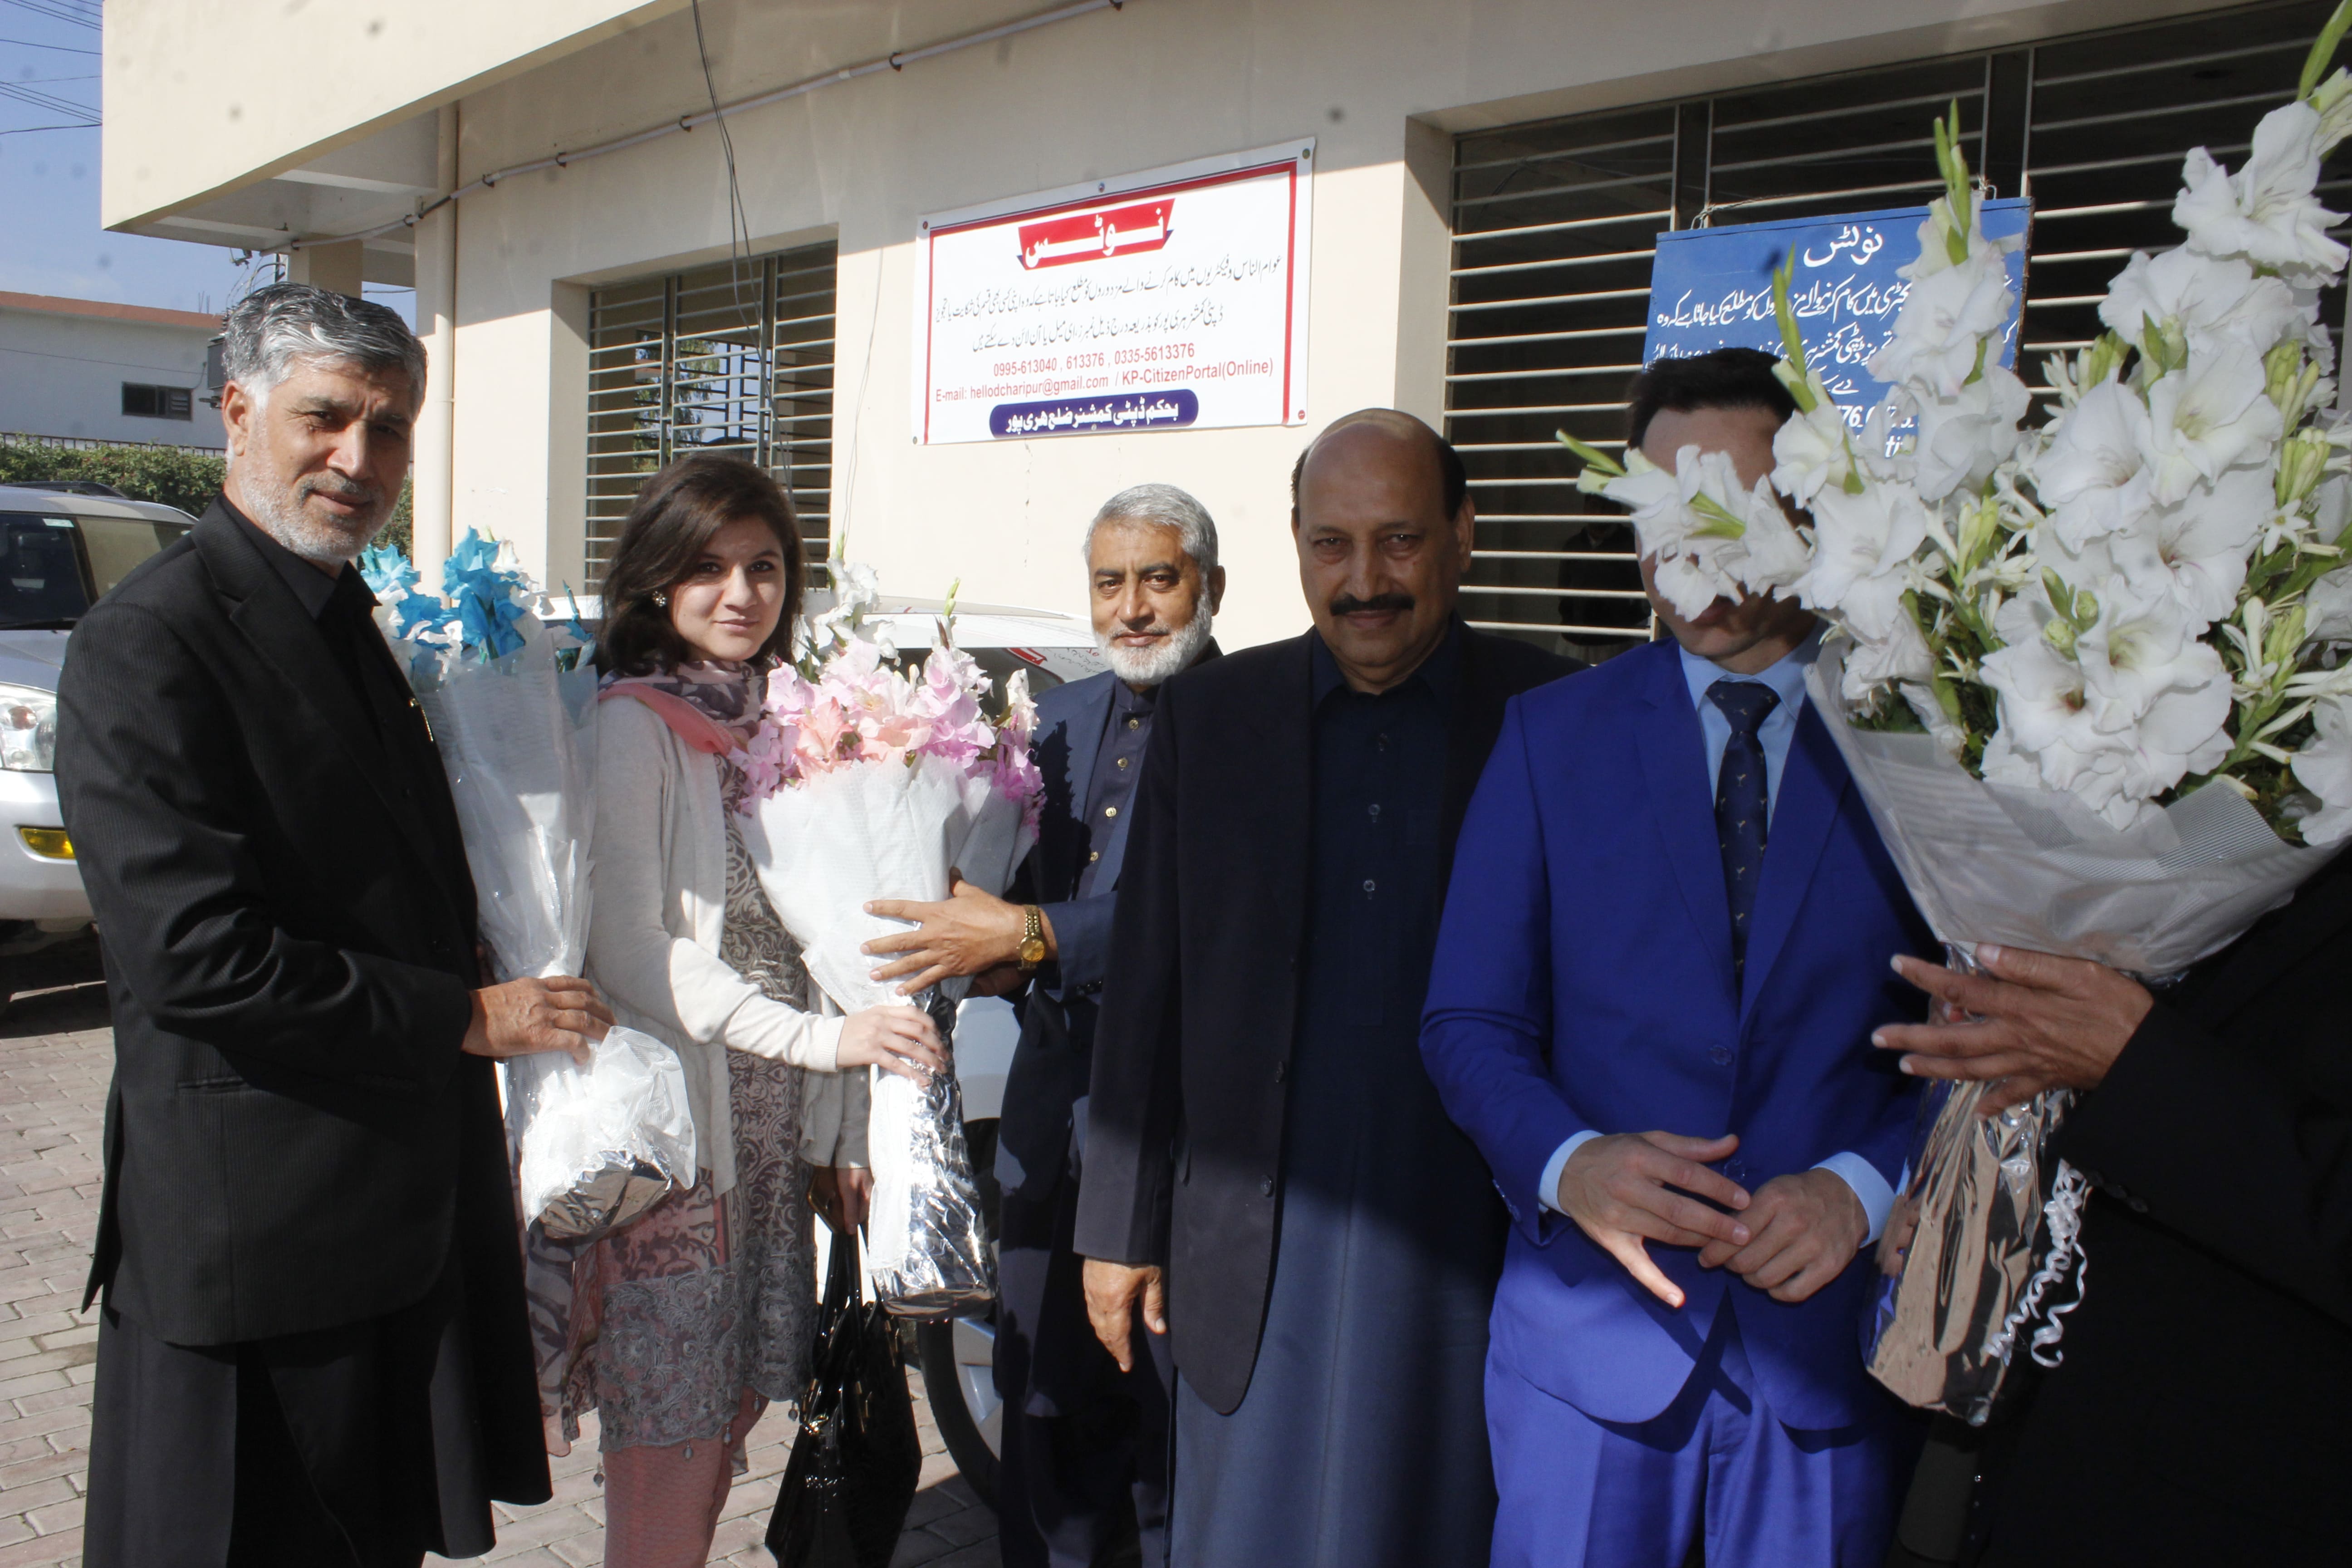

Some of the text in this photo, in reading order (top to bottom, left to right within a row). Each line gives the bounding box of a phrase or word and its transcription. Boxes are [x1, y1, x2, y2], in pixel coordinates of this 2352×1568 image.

[1025, 208, 1164, 268] نوٹس
[1803, 225, 1883, 267] نوٹس
[1180, 265, 1195, 288] میں
[1196, 254, 1229, 286] فیکٹریوں
[1234, 258, 1261, 281] الناس
[1260, 255, 1282, 284] عوام
[1060, 285, 1071, 307] کیا
[1071, 274, 1088, 303] مطلع
[1089, 283, 1122, 301] مزدوروں
[1166, 270, 1181, 296] کام
[952, 299, 974, 318] شکایت
[979, 289, 990, 321] قسم
[1034, 294, 1047, 312] ہے
[1048, 287, 1060, 308] جاتا
[1709, 289, 1736, 326] کیا
[1720, 289, 1754, 325] مطلع
[1742, 284, 1772, 321] کو
[1833, 282, 1873, 324] کام
[1853, 287, 1878, 316] میں
[1093, 313, 1110, 338] ذیل
[1186, 297, 1208, 331] کمشنر
[1203, 299, 1223, 327] ڈپٹی
[1693, 302, 1708, 326] جاتا
[1049, 319, 1065, 343] میل
[1111, 318, 1128, 336] درج
[973, 334, 983, 352] ہیں
[994, 358, 1057, 377] 0995-613040
[1066, 353, 1104, 369] 613376
[1115, 343, 1195, 365] 0335-5613376
[936, 387, 967, 402] E-mail:
[970, 376, 1108, 398] hellodcharipur@gmail.com
[1122, 358, 1273, 386] KP-CitizenPortal(Online)
[1005, 414, 1023, 435] پور
[1048, 407, 1073, 430] ضلع
[1072, 403, 1113, 428] کمشنر
[1113, 396, 1145, 427] ڈپٹی
[1146, 399, 1179, 425] بحکم
